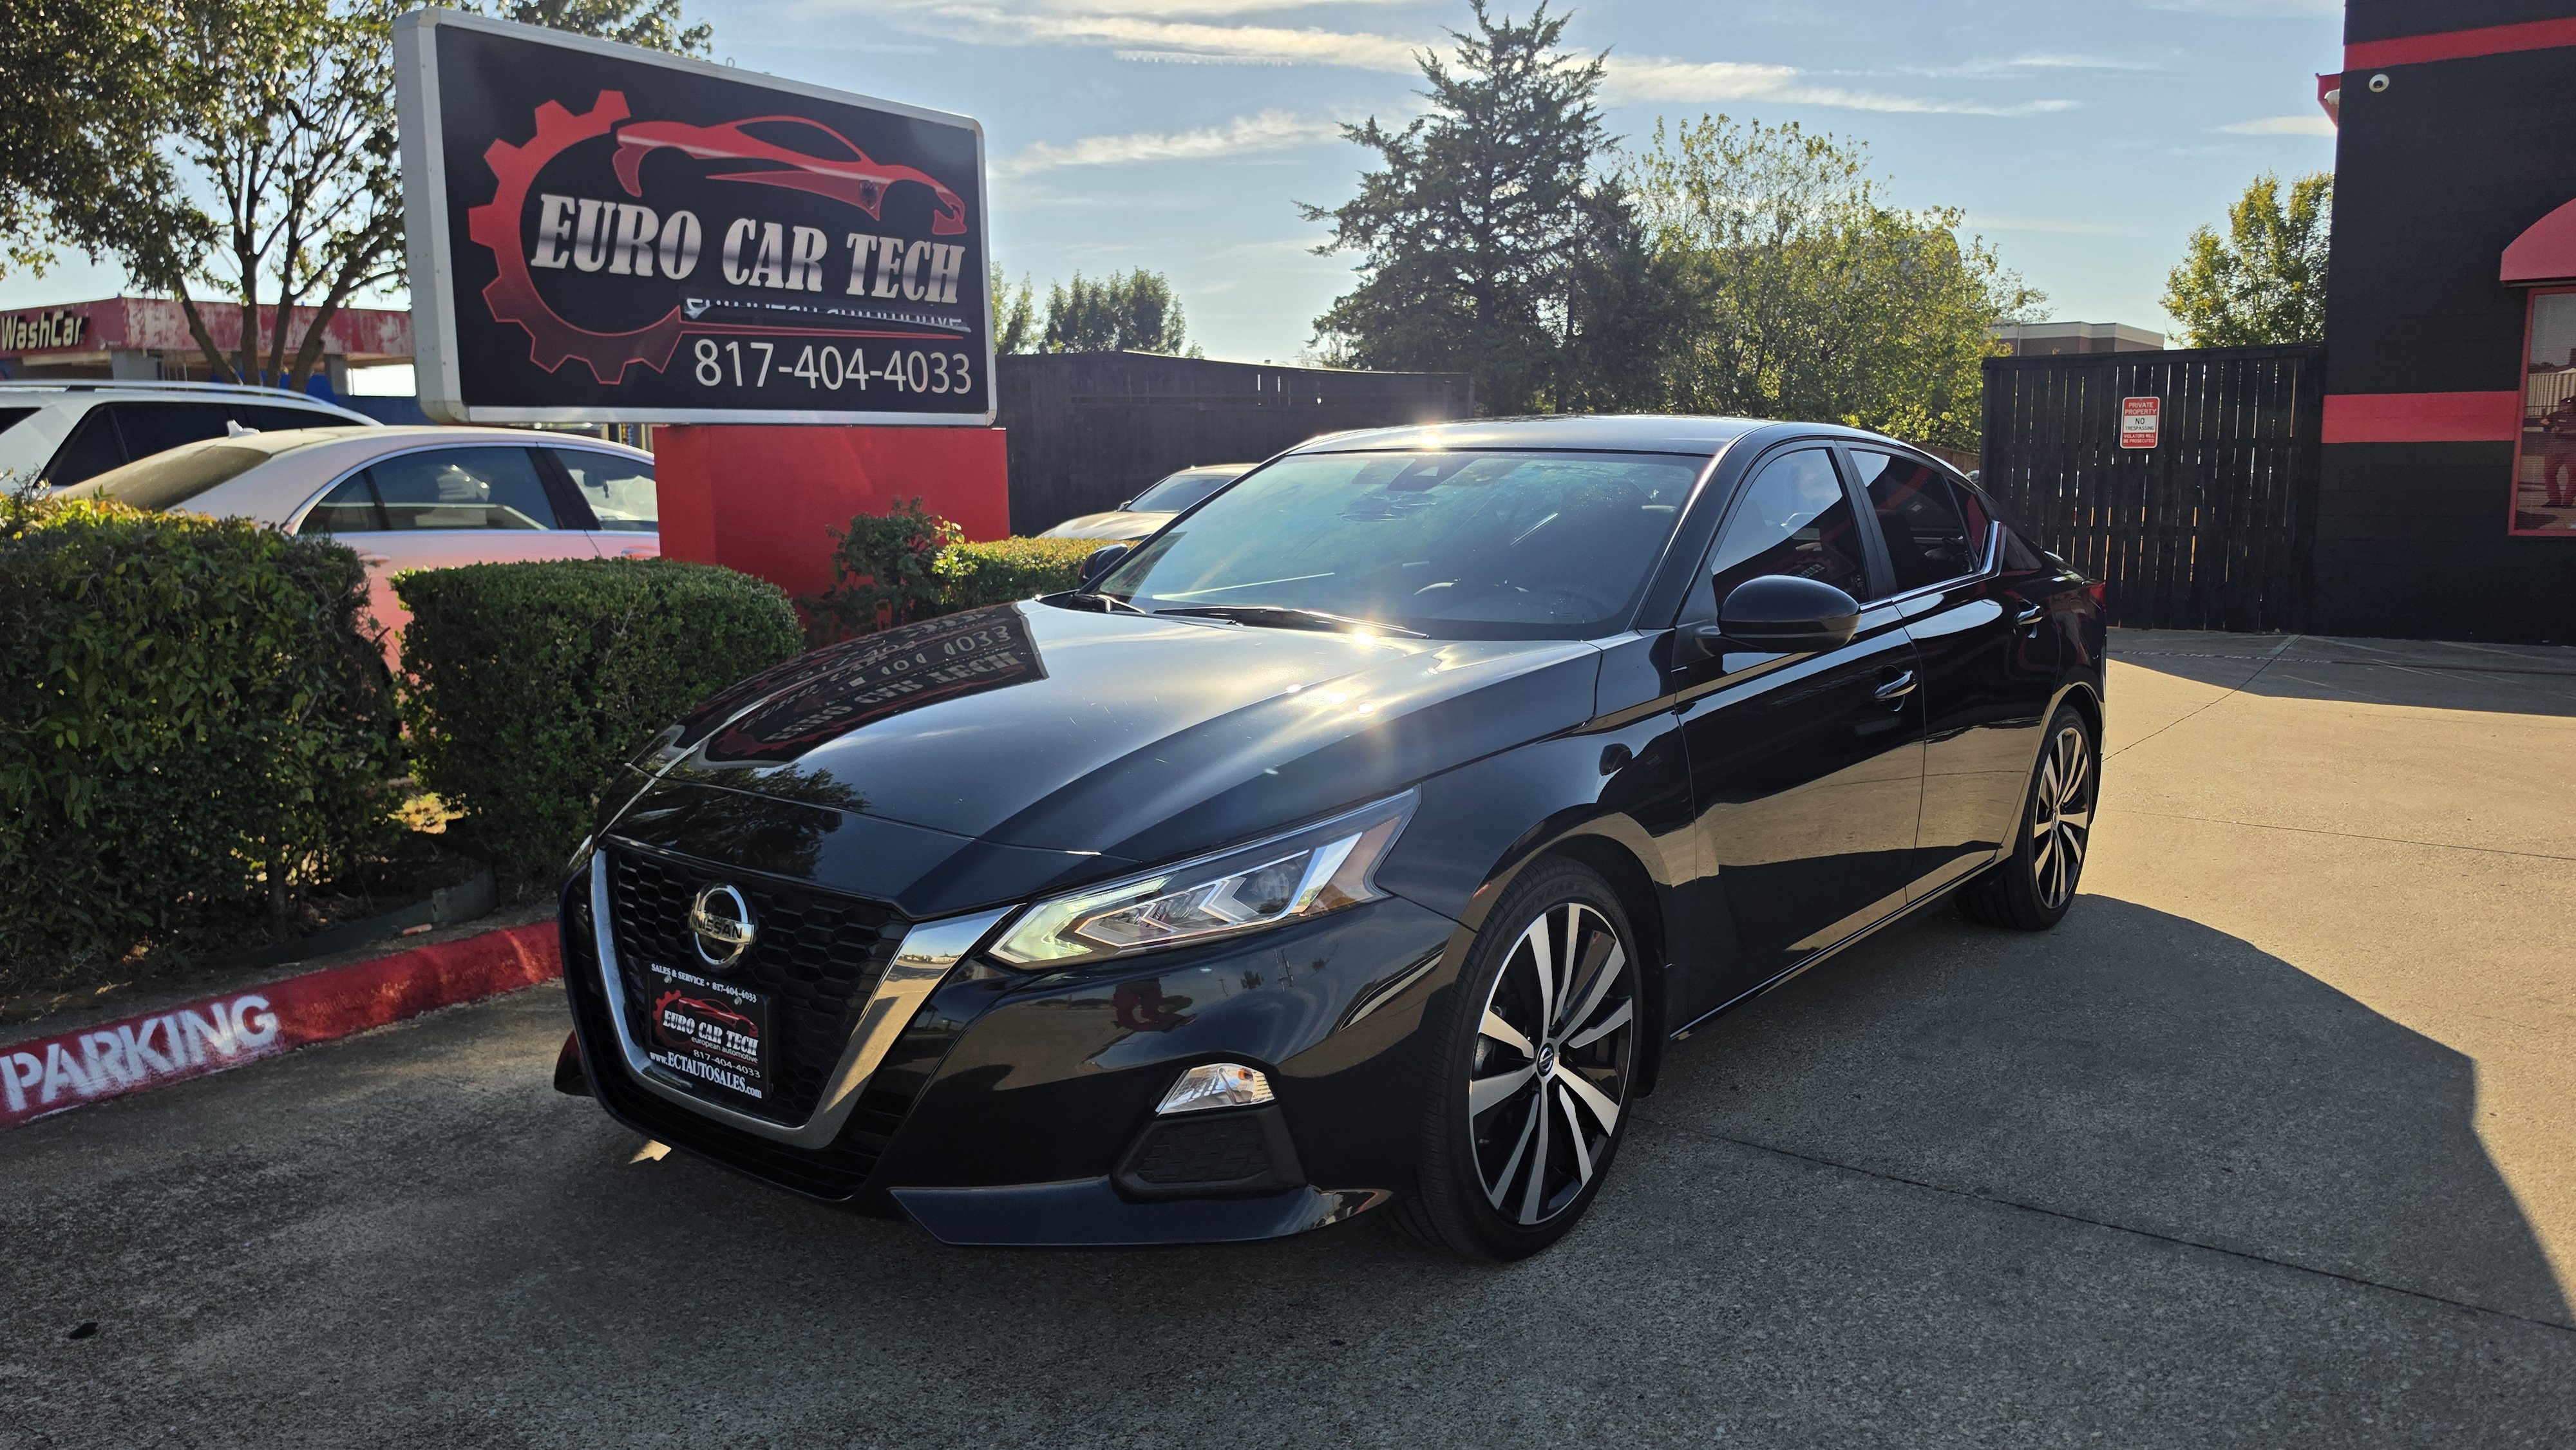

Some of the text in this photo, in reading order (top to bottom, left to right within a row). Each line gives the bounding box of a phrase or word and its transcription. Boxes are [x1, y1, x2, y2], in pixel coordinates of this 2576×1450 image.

[531, 194, 965, 303] EURO CAR TECH
[1, 310, 82, 351] WashCar
[694, 339, 971, 394] 817-404-4033
[696, 918, 743, 939] NISSAN
[651, 963, 671, 975] SALES
[678, 971, 705, 986] SERVICE
[712, 982, 757, 1003] 817-404-4033
[0, 995, 278, 1112] PARKING
[663, 1010, 759, 1056] EURO CAR TECH
[691, 1036, 759, 1064] european automotive
[650, 1051, 762, 1098] www.ECTAUTOSALES.com
[694, 1049, 761, 1078] 817-404-4033
